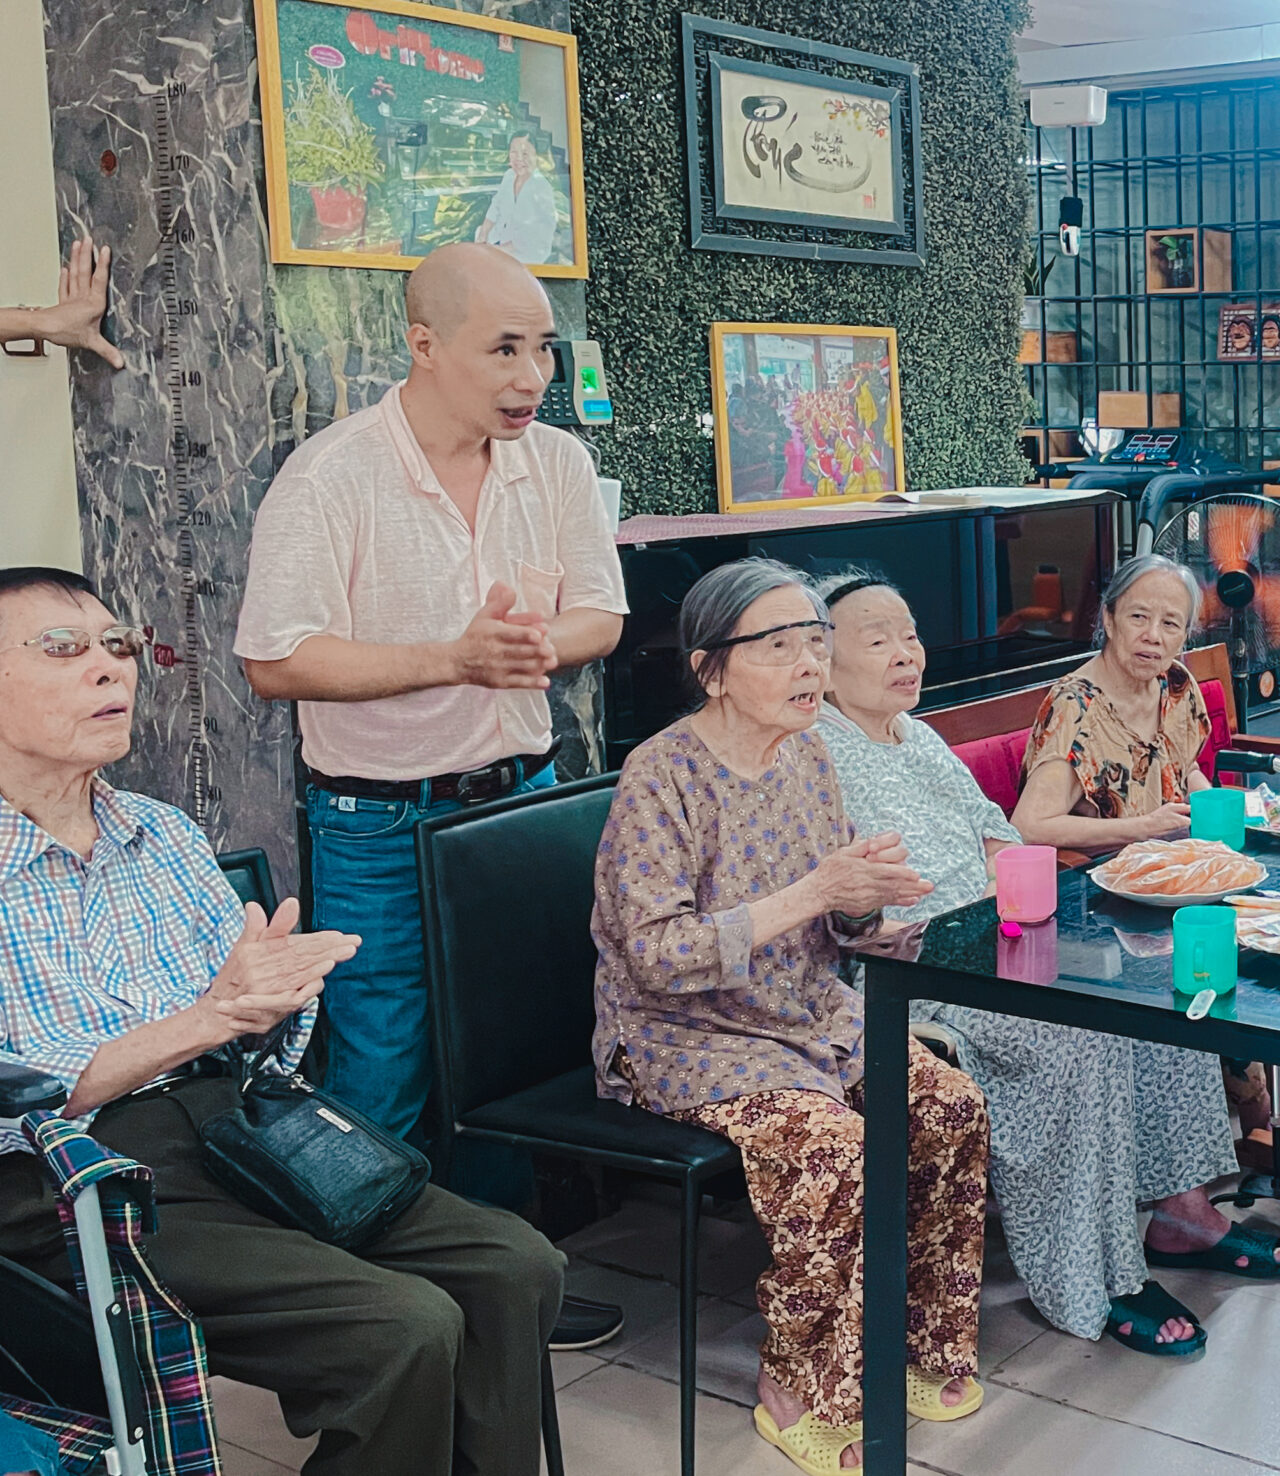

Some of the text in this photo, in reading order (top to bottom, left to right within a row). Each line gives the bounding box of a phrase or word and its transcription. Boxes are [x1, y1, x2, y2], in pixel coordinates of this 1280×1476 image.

[167, 84, 187, 98] 180
[169, 155, 190, 172] 170
[175, 229, 195, 243] 160
[178, 301, 199, 316] 150
[181, 371, 201, 387] 140
[192, 511, 211, 526] 120
[203, 716, 217, 733] 90
